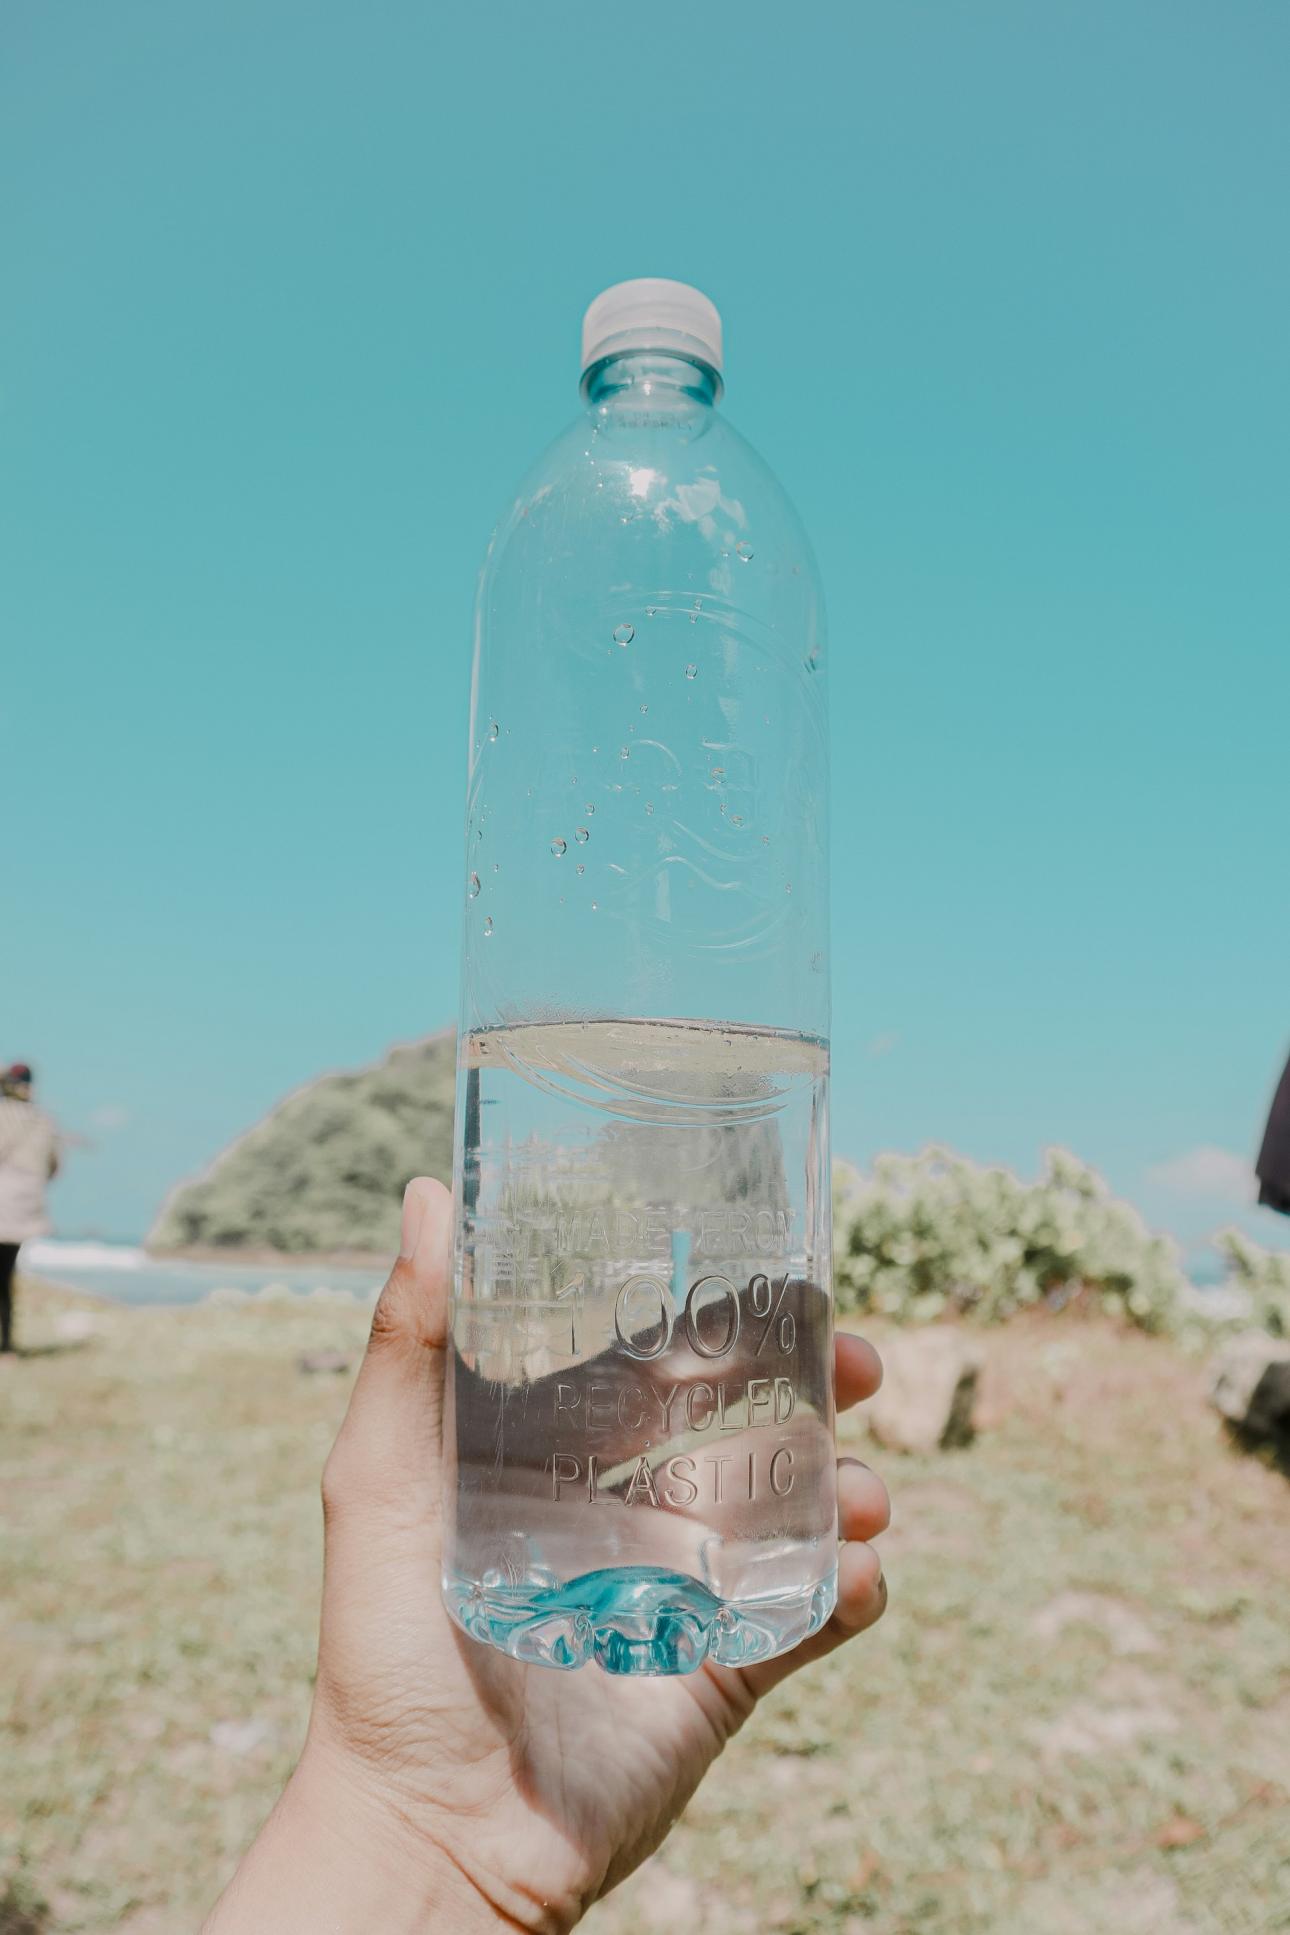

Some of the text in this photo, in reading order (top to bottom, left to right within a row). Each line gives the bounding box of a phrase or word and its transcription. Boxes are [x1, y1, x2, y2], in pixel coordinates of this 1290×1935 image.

[555, 1209, 796, 1252] MADE FROM
[555, 1273, 796, 1361] 100%
[553, 1377, 796, 1432] RECYCLED
[552, 1447, 796, 1508] PLASTIC
